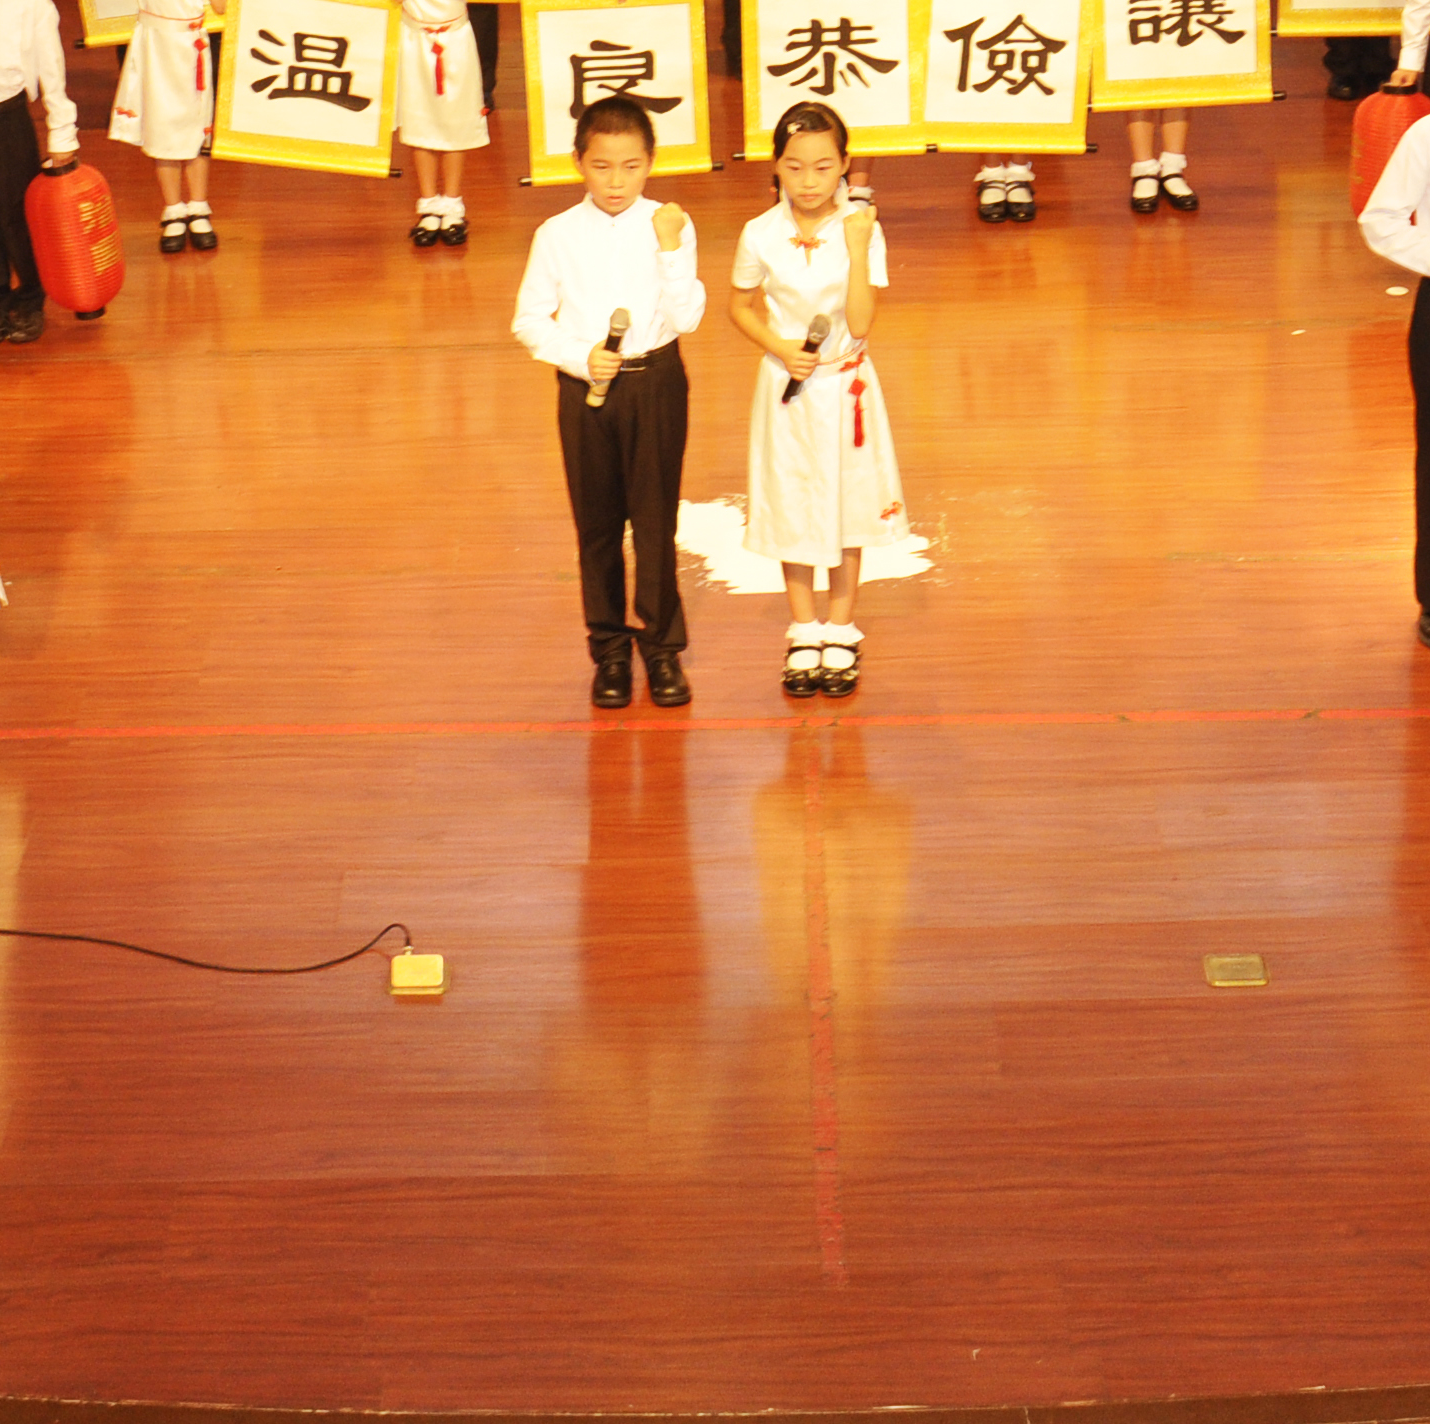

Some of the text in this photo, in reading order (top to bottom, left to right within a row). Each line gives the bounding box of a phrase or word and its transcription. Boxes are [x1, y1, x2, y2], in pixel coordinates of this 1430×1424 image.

[569, 39, 683, 119] 良
[766, 17, 900, 96] 恭
[943, 14, 1067, 97] 儉
